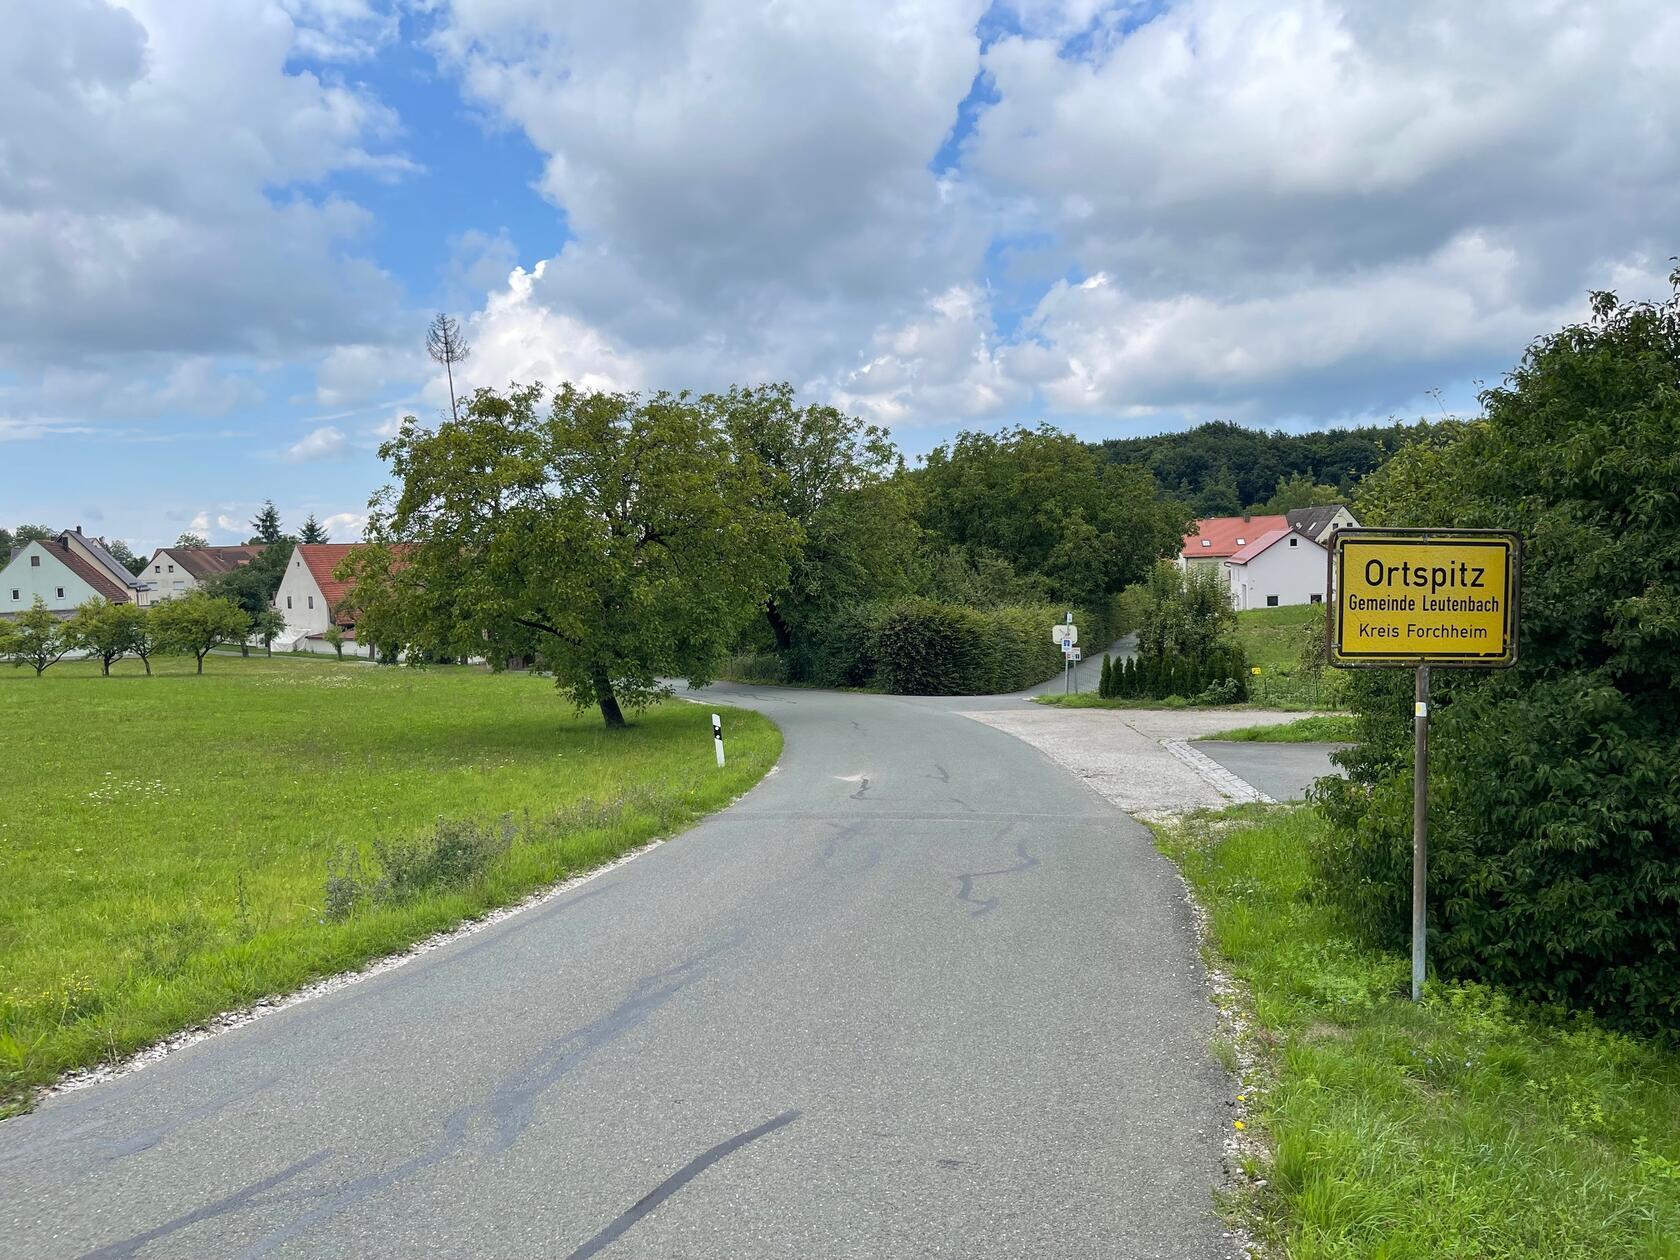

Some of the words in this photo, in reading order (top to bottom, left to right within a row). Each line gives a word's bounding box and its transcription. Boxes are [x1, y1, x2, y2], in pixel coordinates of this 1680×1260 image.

[1365, 559, 1485, 594] Ortspitz
[1349, 594, 1415, 611] Gemeinde
[1422, 595, 1498, 612] Leutenbach
[1359, 623, 1399, 638] Kreis
[1407, 624, 1487, 639] Forchheim
